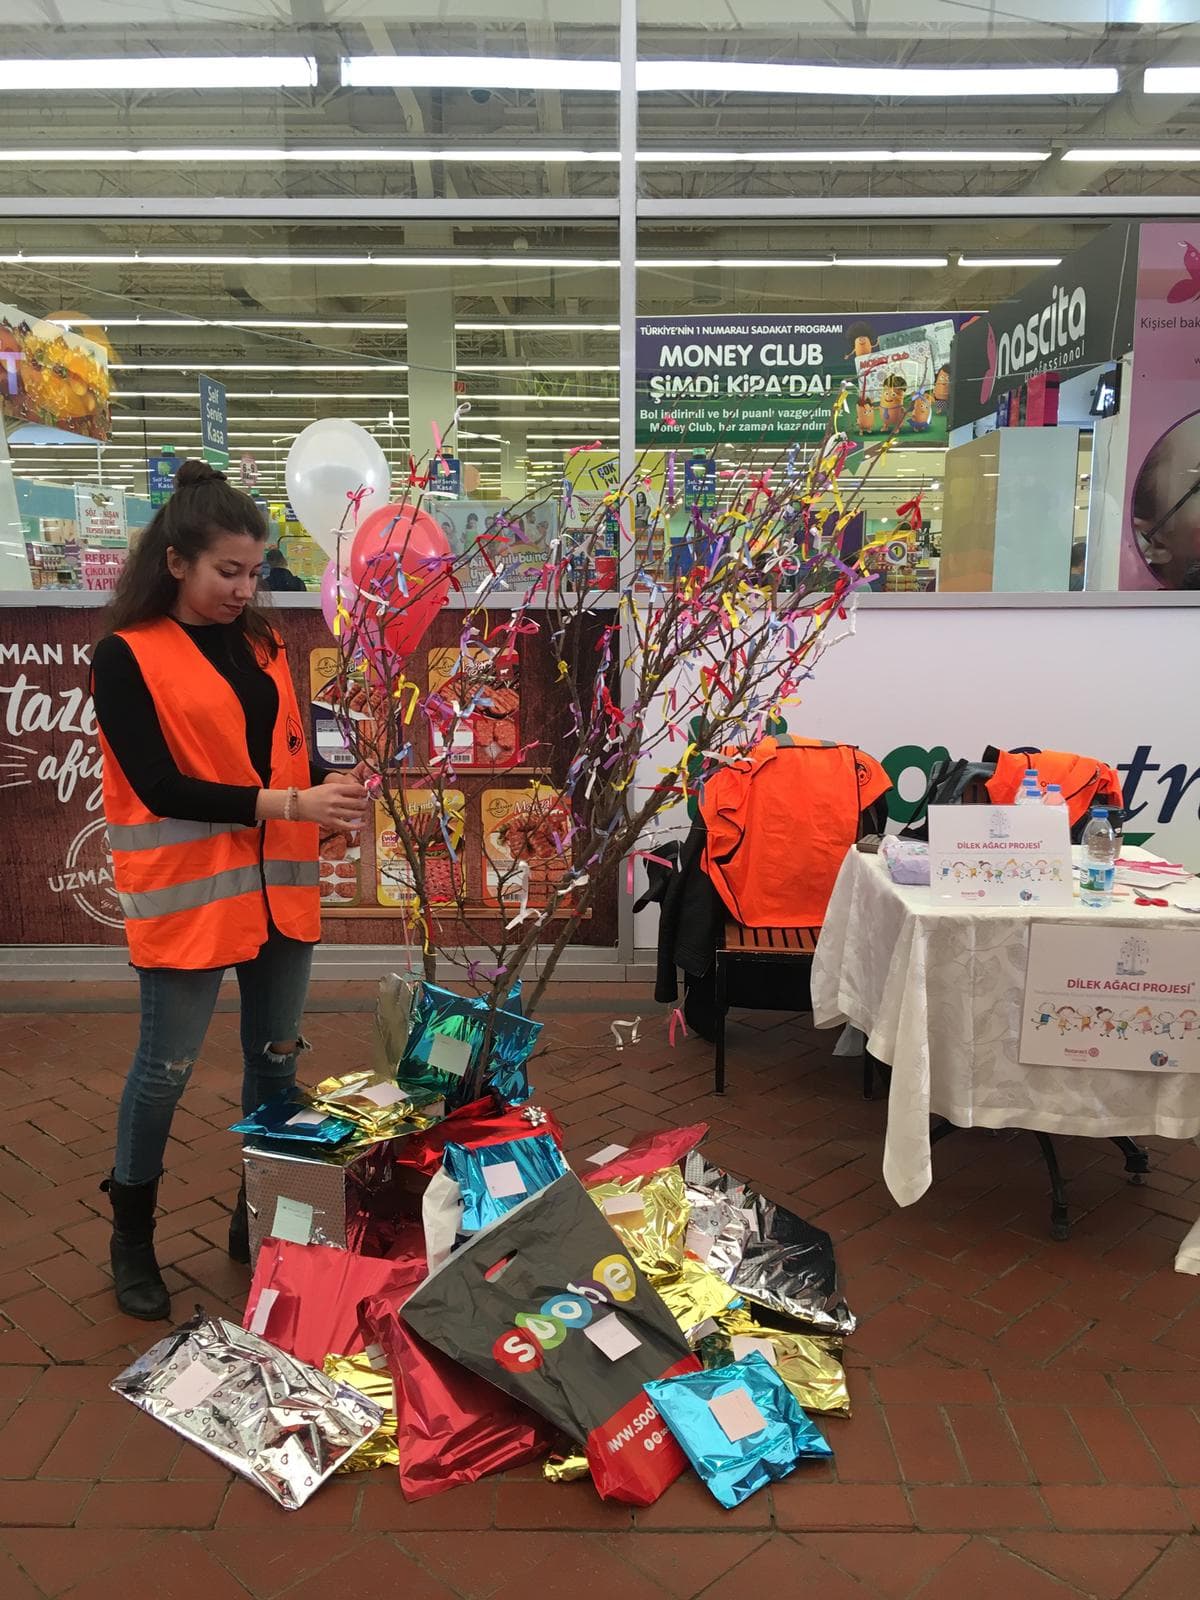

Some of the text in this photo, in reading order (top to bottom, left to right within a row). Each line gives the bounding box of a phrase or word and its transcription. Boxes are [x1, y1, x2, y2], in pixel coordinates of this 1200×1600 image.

[640, 324, 843, 336] TÜRKİYE'NİN 1 NUMARALI SADAKAT PROGRAMI
[998, 284, 1087, 378] nascita
[1140, 316, 1177, 331] Kişisel
[659, 343, 824, 367] MONEY CLUB
[207, 385, 219, 404] Self
[206, 402, 223, 423] Servis
[640, 409, 658, 419] Bol
[661, 409, 705, 419] indirimli
[722, 409, 739, 419] bol
[207, 421, 224, 445] Kasa
[650, 423, 686, 434] Money
[688, 423, 716, 433] Club,
[718, 423, 736, 432] her
[738, 424, 774, 432] zaman
[957, 840, 1042, 850] DİLEK AĞACI PROJESİ
[48, 867, 115, 893] UZMA
[1066, 977, 1192, 995] DİLEK AĞACI PROJESİ
